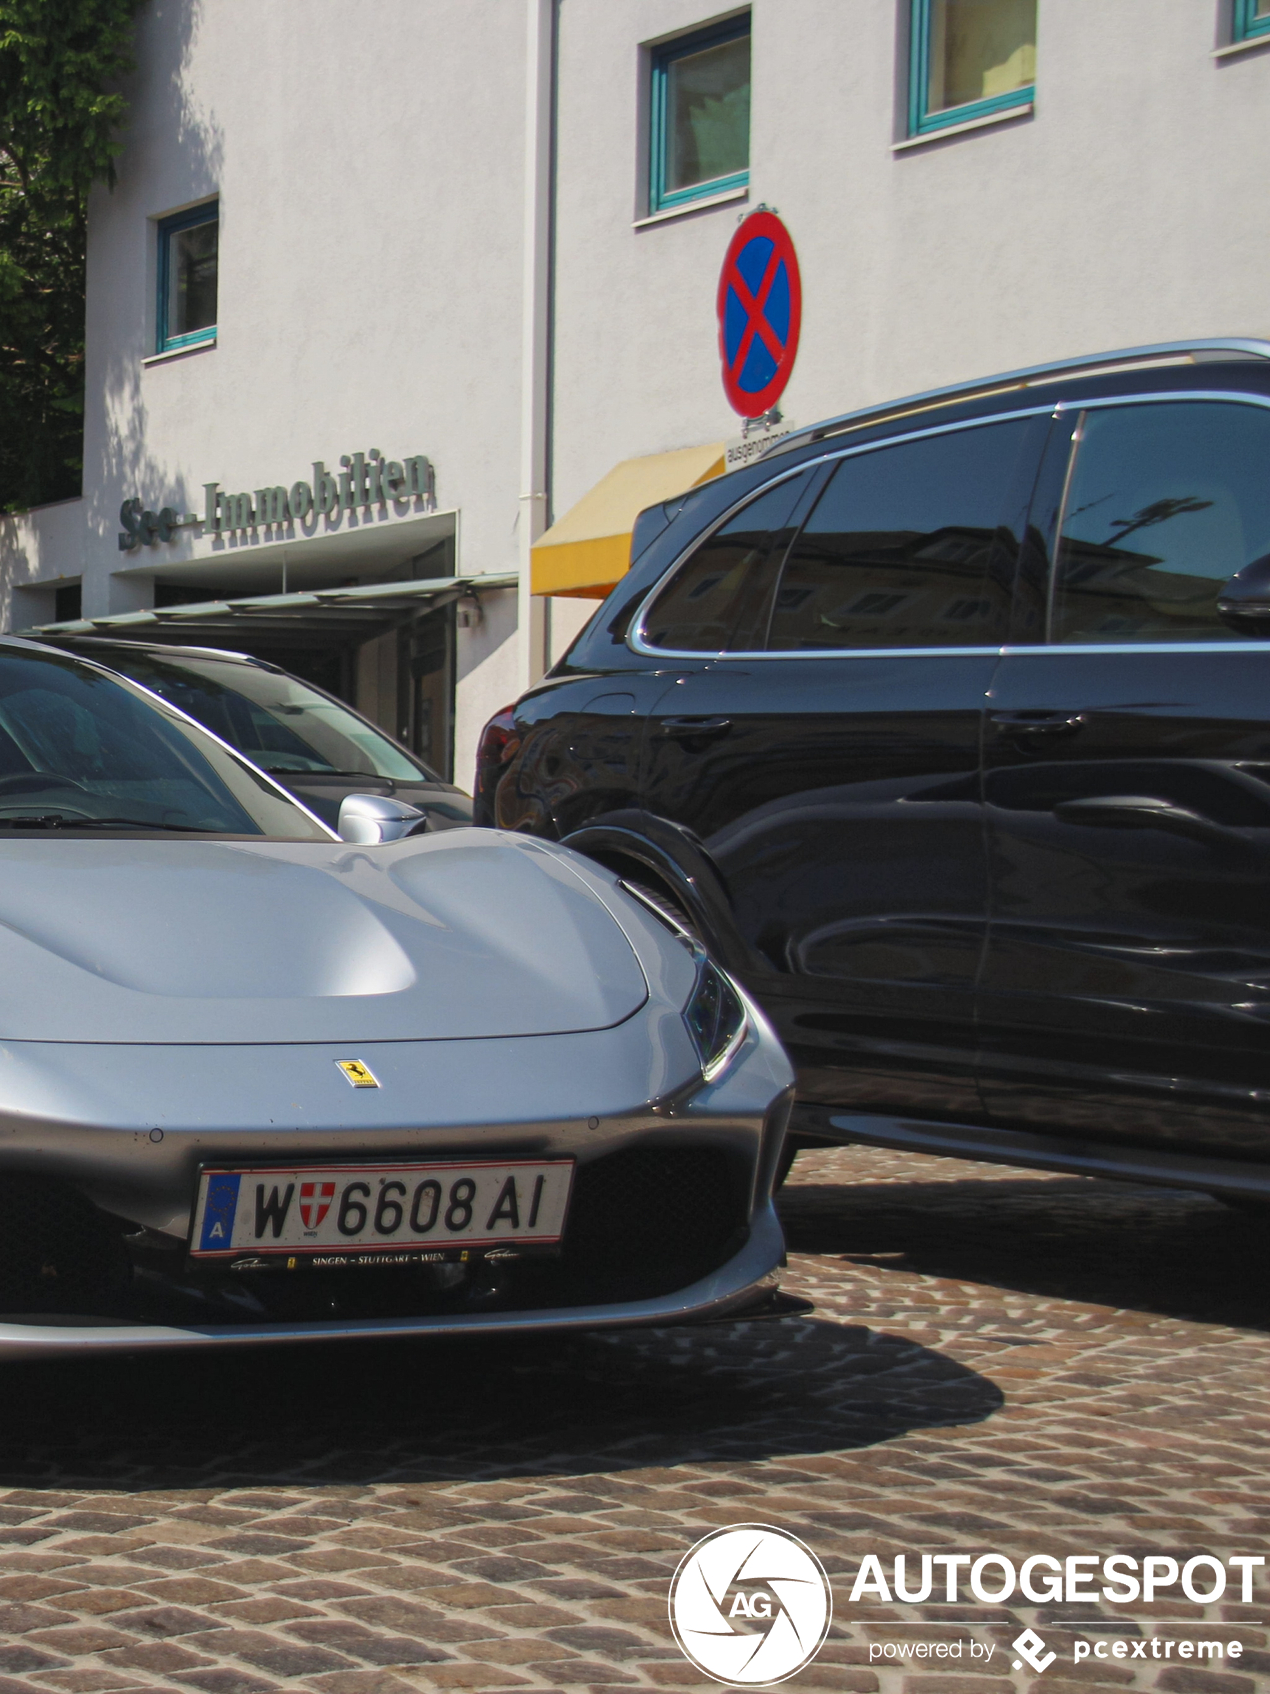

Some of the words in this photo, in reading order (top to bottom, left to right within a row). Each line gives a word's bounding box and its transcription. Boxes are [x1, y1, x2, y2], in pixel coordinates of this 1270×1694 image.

[209, 1221, 224, 1238] A
[254, 1183, 296, 1239] W
[312, 1256, 348, 1266] SINGEN
[357, 1254, 411, 1265] STUTTGART
[421, 1252, 446, 1262] WIEN
